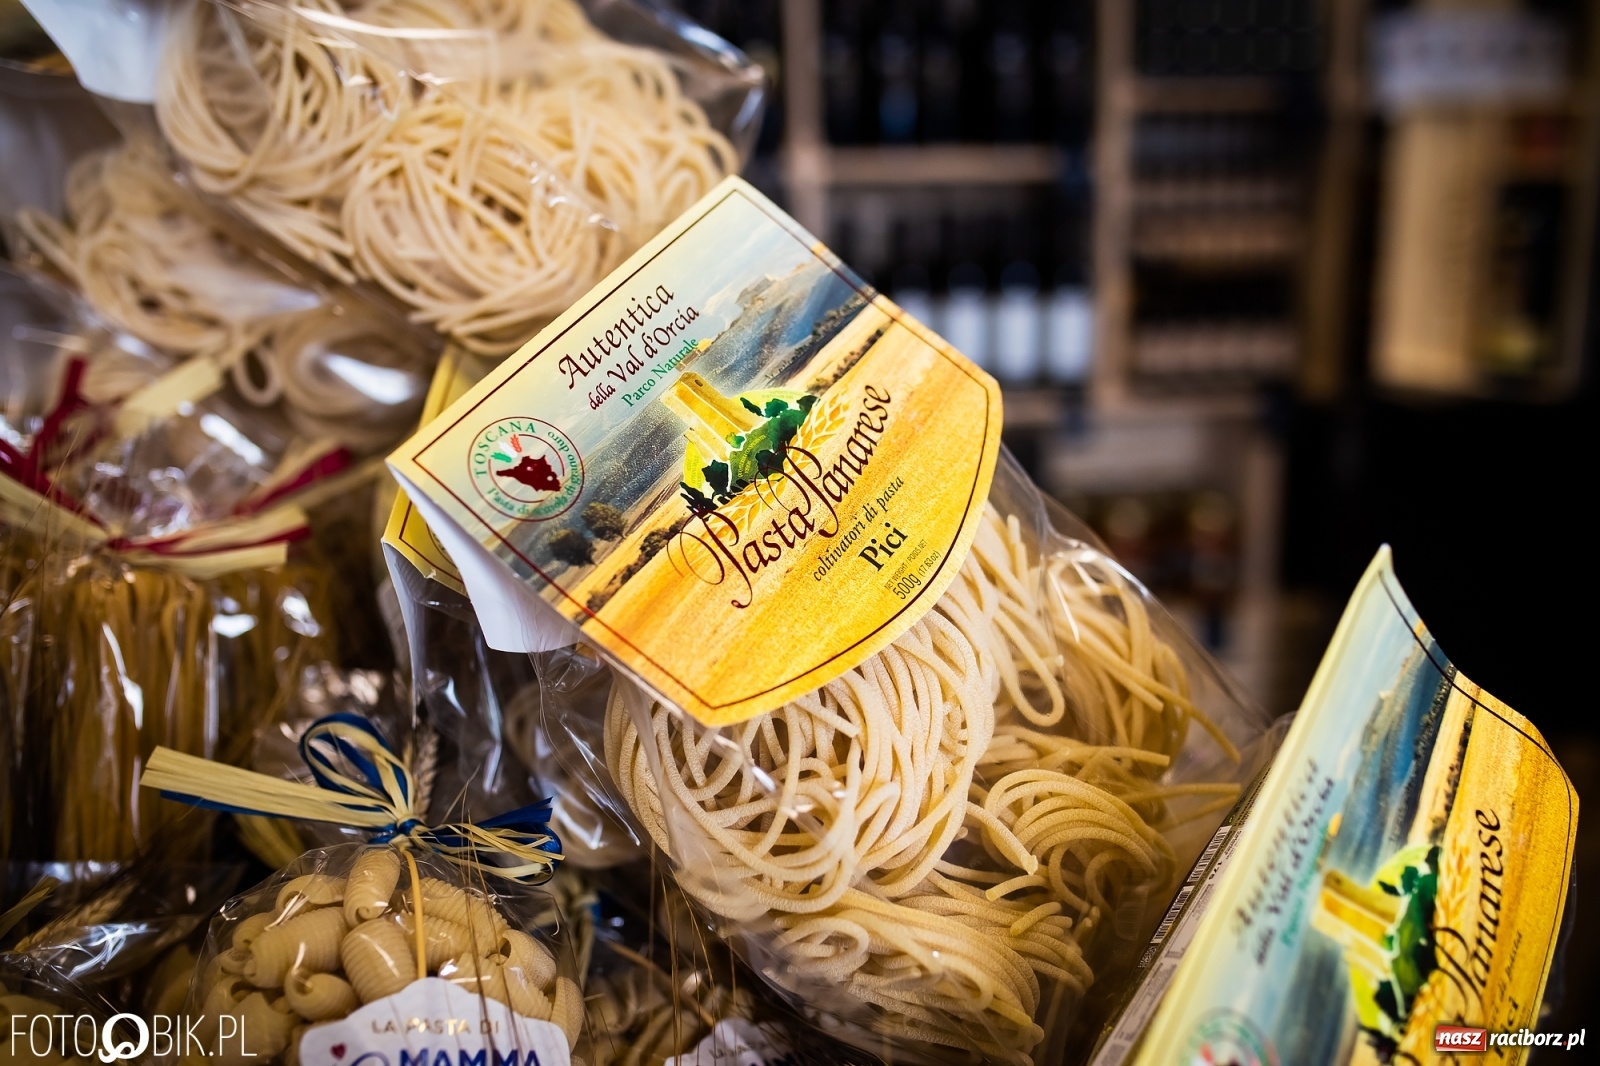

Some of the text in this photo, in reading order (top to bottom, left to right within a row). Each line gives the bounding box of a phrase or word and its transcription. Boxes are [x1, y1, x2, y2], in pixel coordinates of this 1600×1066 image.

[558, 285, 674, 390] Autentica
[588, 382, 616, 411] della
[606, 344, 645, 383] Val
[621, 337, 699, 407] Parco Naturale
[474, 421, 536, 479] TOSCANA
[547, 431, 570, 453] duro
[667, 385, 891, 609] Pasta Panarese
[813, 476, 904, 582] coltivatori di pasta
[858, 521, 908, 572] Pici
[884, 579, 894, 590] NET
[892, 562, 909, 581] WEIGHT
[892, 573, 922, 600] 500g
[1431, 808, 1504, 1024] Panarese
[372, 1017, 499, 1036] LA PASTA DI
